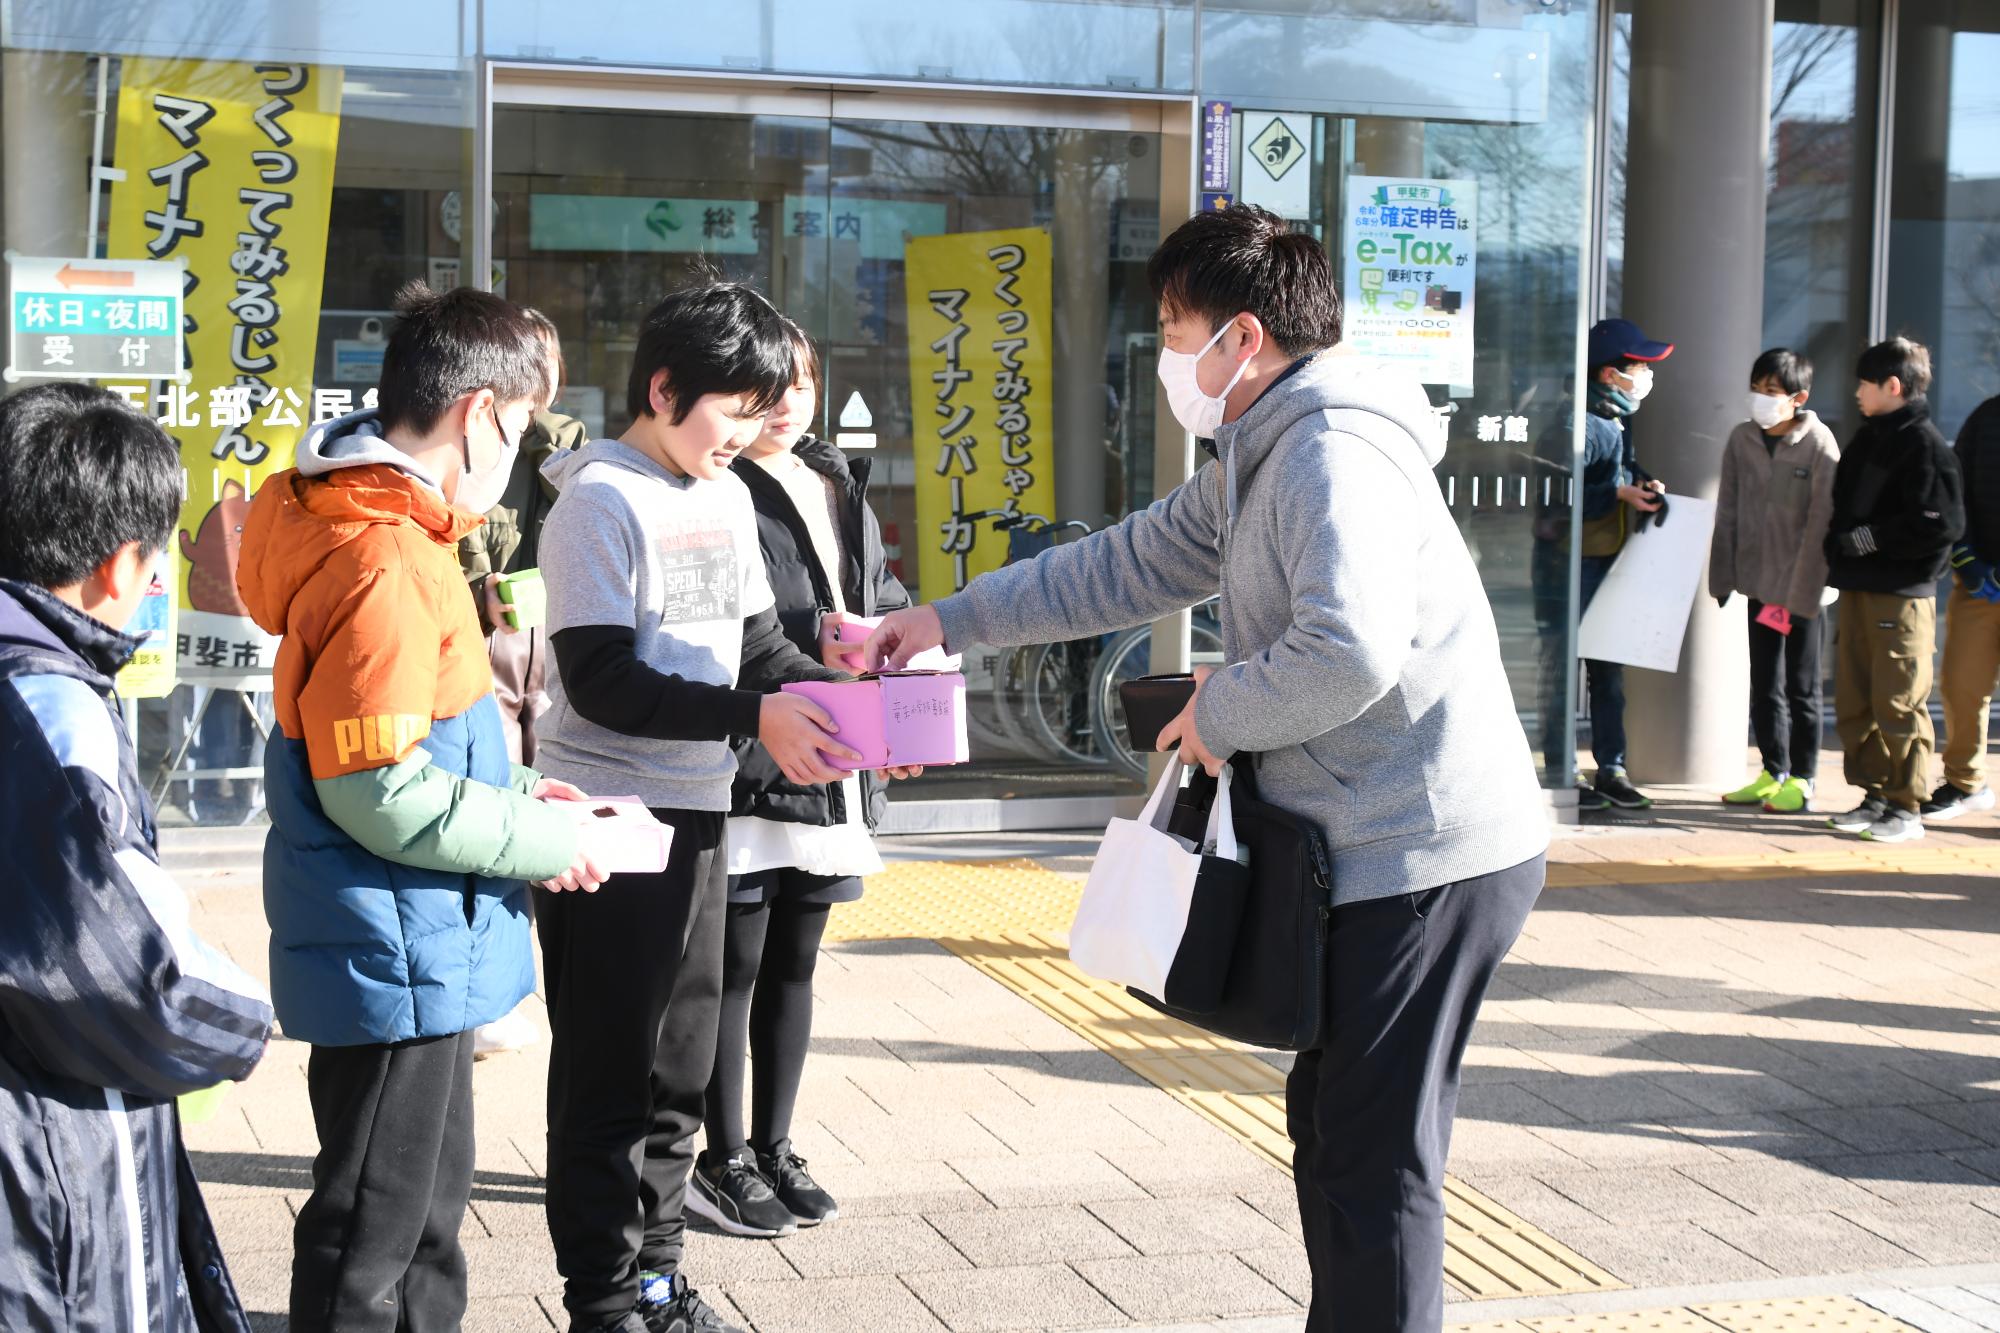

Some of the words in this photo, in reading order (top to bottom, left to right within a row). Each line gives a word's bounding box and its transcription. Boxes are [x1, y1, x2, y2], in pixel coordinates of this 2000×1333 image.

[1397, 186, 1430, 199] 甲斐市
[1380, 206, 1469, 231] 確定申告は
[1388, 269, 1434, 283] 便利です
[22, 297, 169, 331] 休日・夜間
[107, 385, 379, 428] 北部公民
